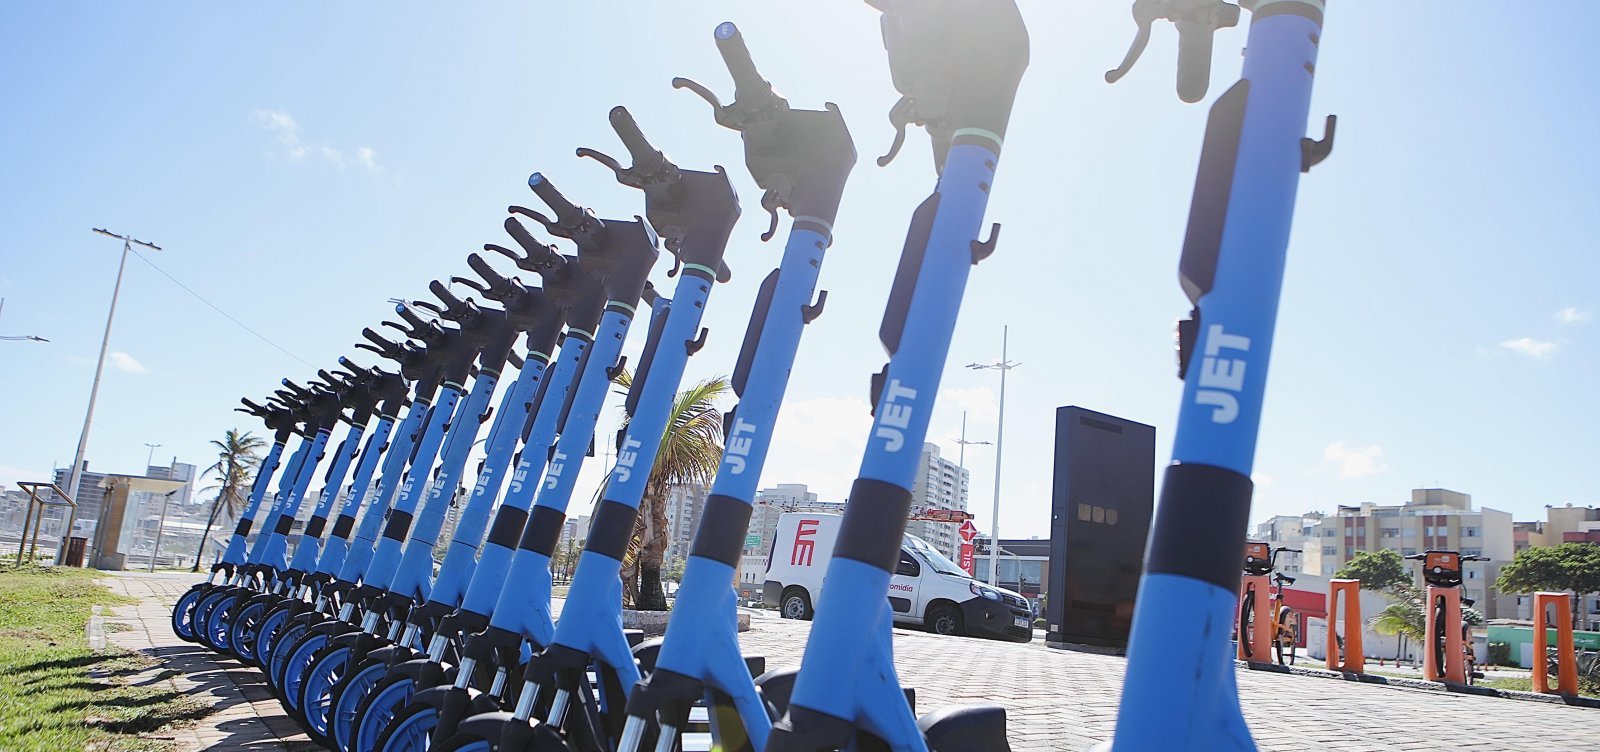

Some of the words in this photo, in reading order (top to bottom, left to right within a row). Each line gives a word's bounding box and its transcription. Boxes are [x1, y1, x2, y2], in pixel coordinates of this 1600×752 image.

[1195, 324, 1251, 424] JET
[876, 379, 918, 452] JET
[614, 435, 642, 483] JET
[725, 417, 757, 475] JET
[474, 465, 494, 497] JET
[511, 456, 531, 493] JET
[543, 448, 568, 490] JET
[285, 491, 297, 509] JET
[318, 489, 330, 509] JET
[345, 487, 358, 507] JET
[399, 474, 416, 502] JET
[432, 470, 449, 500] JET
[245, 496, 255, 513] JET
[273, 494, 284, 511] JET
[889, 583, 914, 592] omidia
